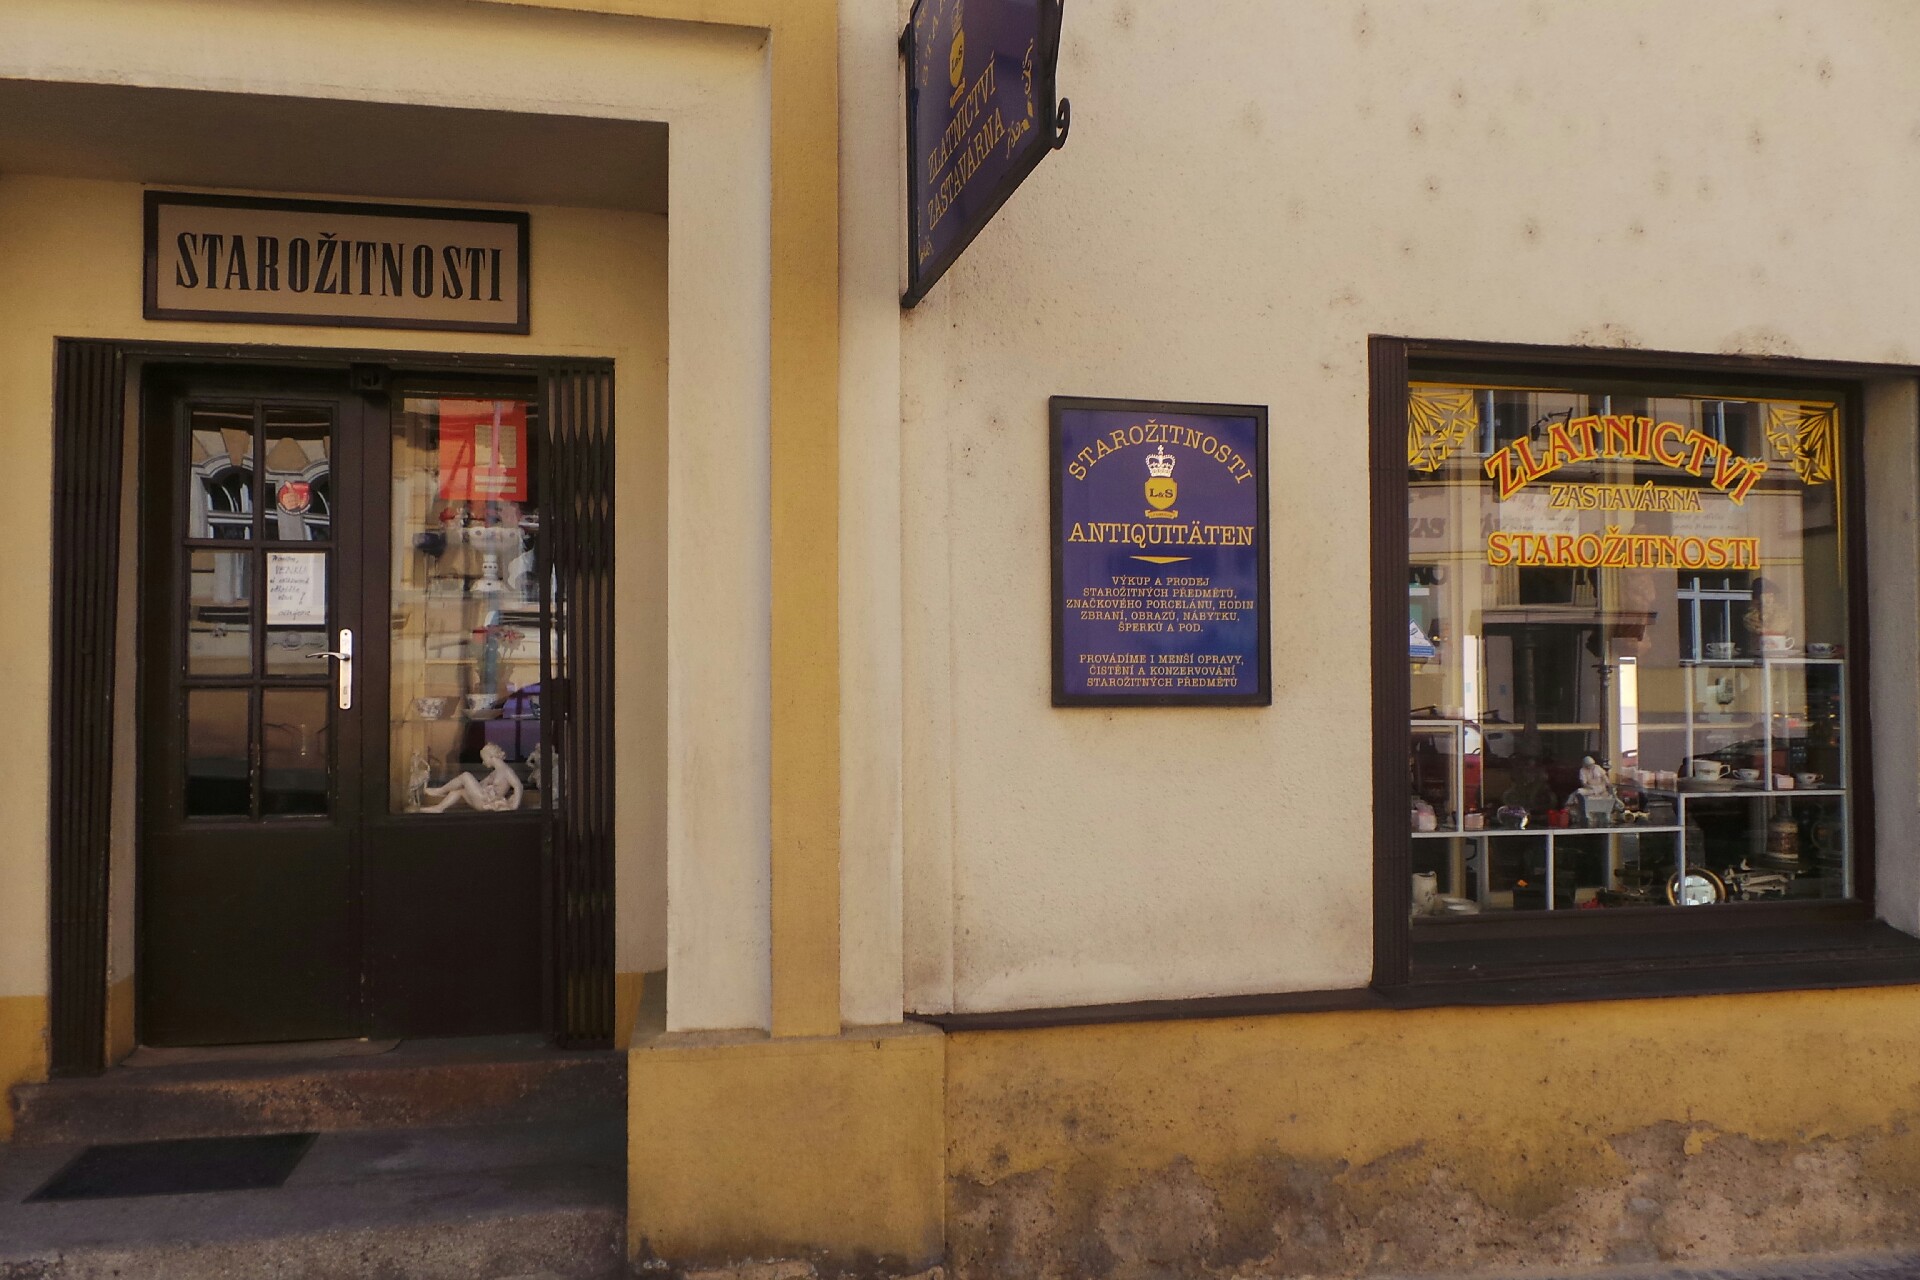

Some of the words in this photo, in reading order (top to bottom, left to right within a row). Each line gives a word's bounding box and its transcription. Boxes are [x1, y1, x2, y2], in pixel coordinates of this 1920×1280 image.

[928, 49, 996, 184] ZLATNICTVÍ
[927, 107, 1005, 231] ZASTAVÁRNA
[176, 232, 503, 302] STAROŽITNOSTI
[1068, 418, 1253, 484] STAROŽITNOSTI
[1484, 415, 1768, 506] ZLATNICTVÍ
[1149, 488, 1174, 499] L&S
[1550, 480, 1703, 512] ZASTAVÁRNA
[1067, 520, 1254, 549] ANTIQUITÄTEN
[1487, 525, 1761, 570] STAROŽITNOSTI
[1112, 575, 1151, 586] VÝKUP
[1154, 576, 1163, 586] A
[1166, 577, 1210, 586] PRODEJ
[1083, 586, 1169, 598] STAROŽITNÝCH
[1066, 598, 1143, 609] ZNAČKOVÉHO
[1146, 600, 1215, 611] PORCELÁNU,
[1219, 601, 1254, 610] HODIN
[1080, 610, 1128, 621] ZBRANÍ,
[1183, 610, 1240, 622] NÁBYTKU,
[1118, 622, 1163, 632] ŠPERKŮ
[1167, 623, 1175, 632] A
[1179, 623, 1204, 632] POD.
[1080, 653, 1147, 664] PROVÁDÍME
[1150, 655, 1155, 664] I
[1158, 654, 1194, 664] MENŠÍ
[1197, 655, 1244, 666] OPRAVY,
[1089, 665, 1134, 675] ČISTĚNÍ
[1138, 666, 1146, 675] A
[1150, 665, 1236, 676] KONZERVOVÁNÍ
[1087, 676, 1173, 687] STAROŽITNÝCH
[1177, 677, 1238, 687] PŘEDMĚTŮ
